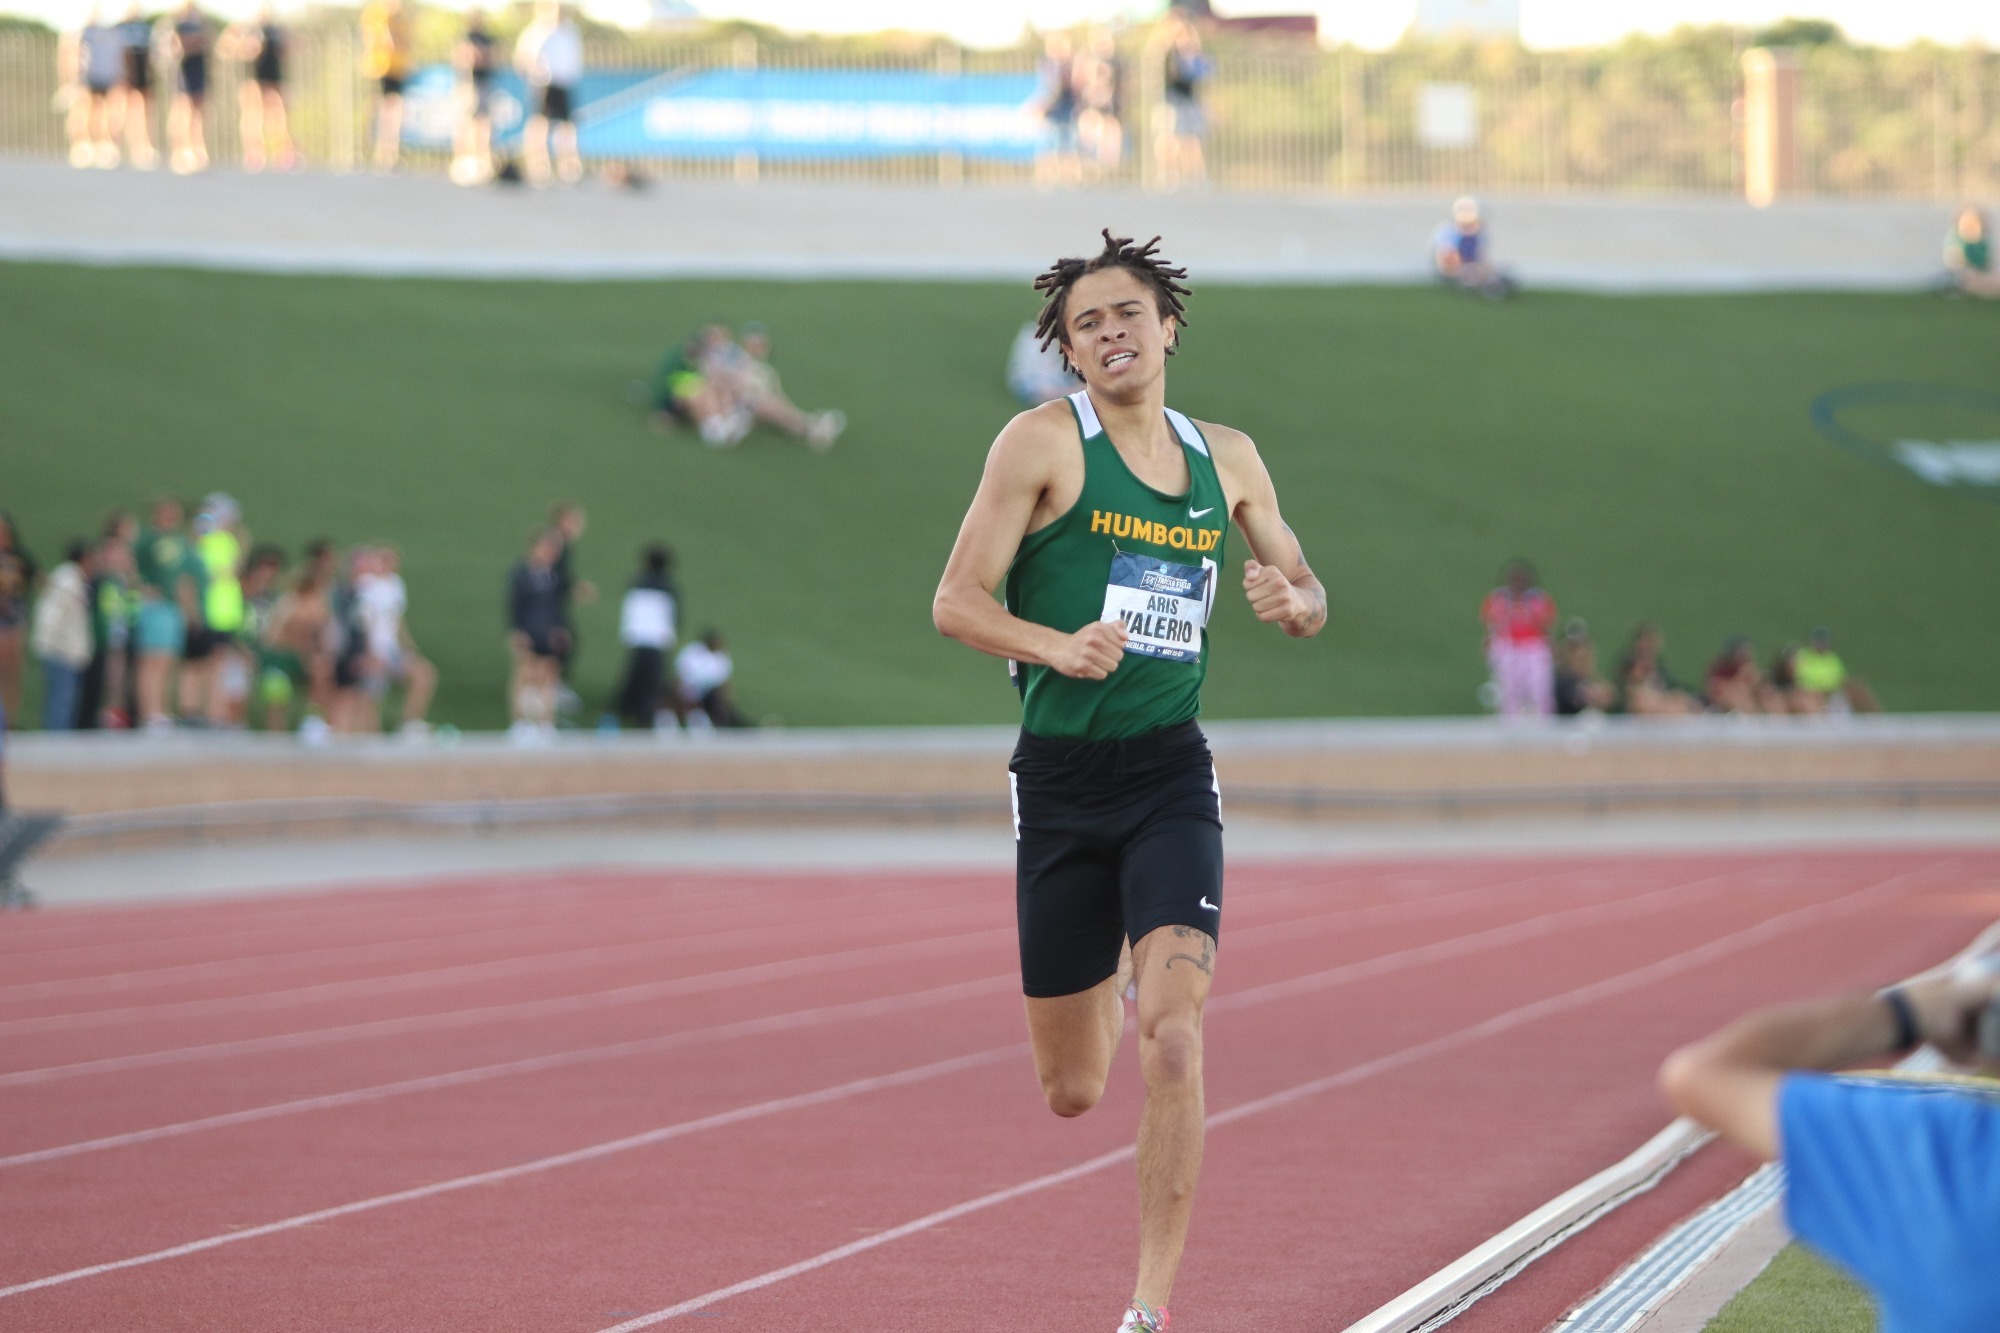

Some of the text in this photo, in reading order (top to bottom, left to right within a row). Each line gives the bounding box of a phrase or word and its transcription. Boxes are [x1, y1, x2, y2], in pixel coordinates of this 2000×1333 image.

[1090, 509, 1222, 551] HUMBOLDT
[1146, 594, 1179, 615] ARIS
[1120, 608, 1193, 643] VALERIO
[1125, 641, 1145, 651] UEBLO,
